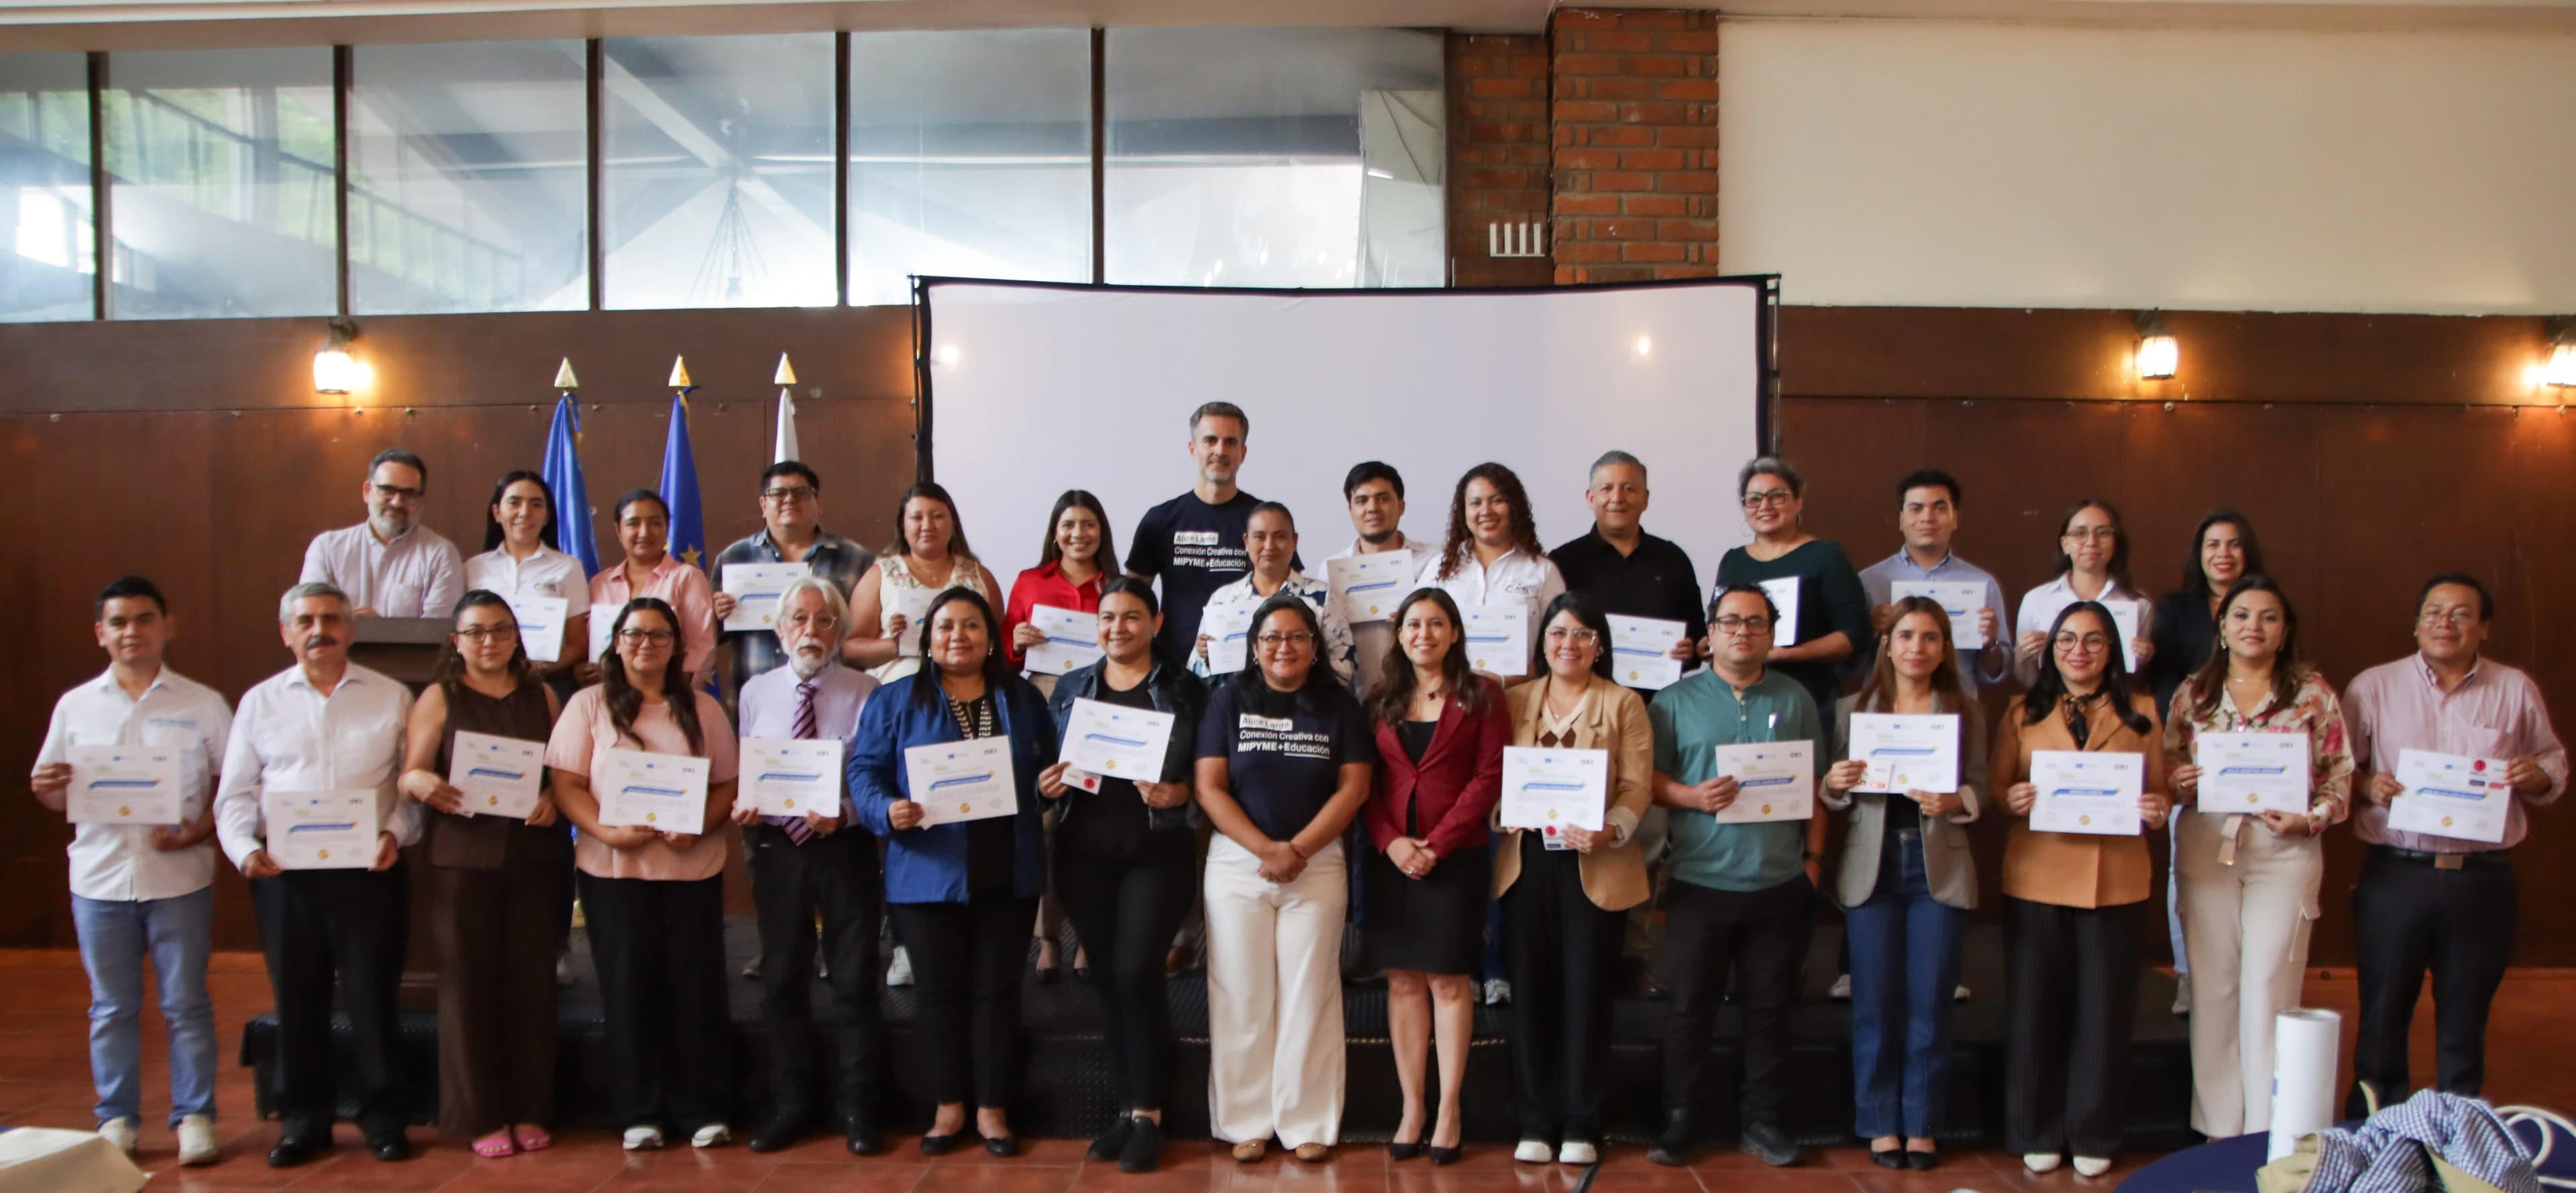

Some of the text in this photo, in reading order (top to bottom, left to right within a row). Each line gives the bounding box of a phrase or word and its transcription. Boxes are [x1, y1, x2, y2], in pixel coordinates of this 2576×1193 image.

[1176, 535, 1194, 543] Alice
[1174, 547, 1247, 557] Conexión Creativa con
[1173, 557, 1246, 568] MIPYME+Educación
[1242, 717, 1289, 730] Alice Lardé
[1240, 730, 1330, 743] Conexión Creativa con
[1238, 741, 1330, 756] MIPYME+Educación
